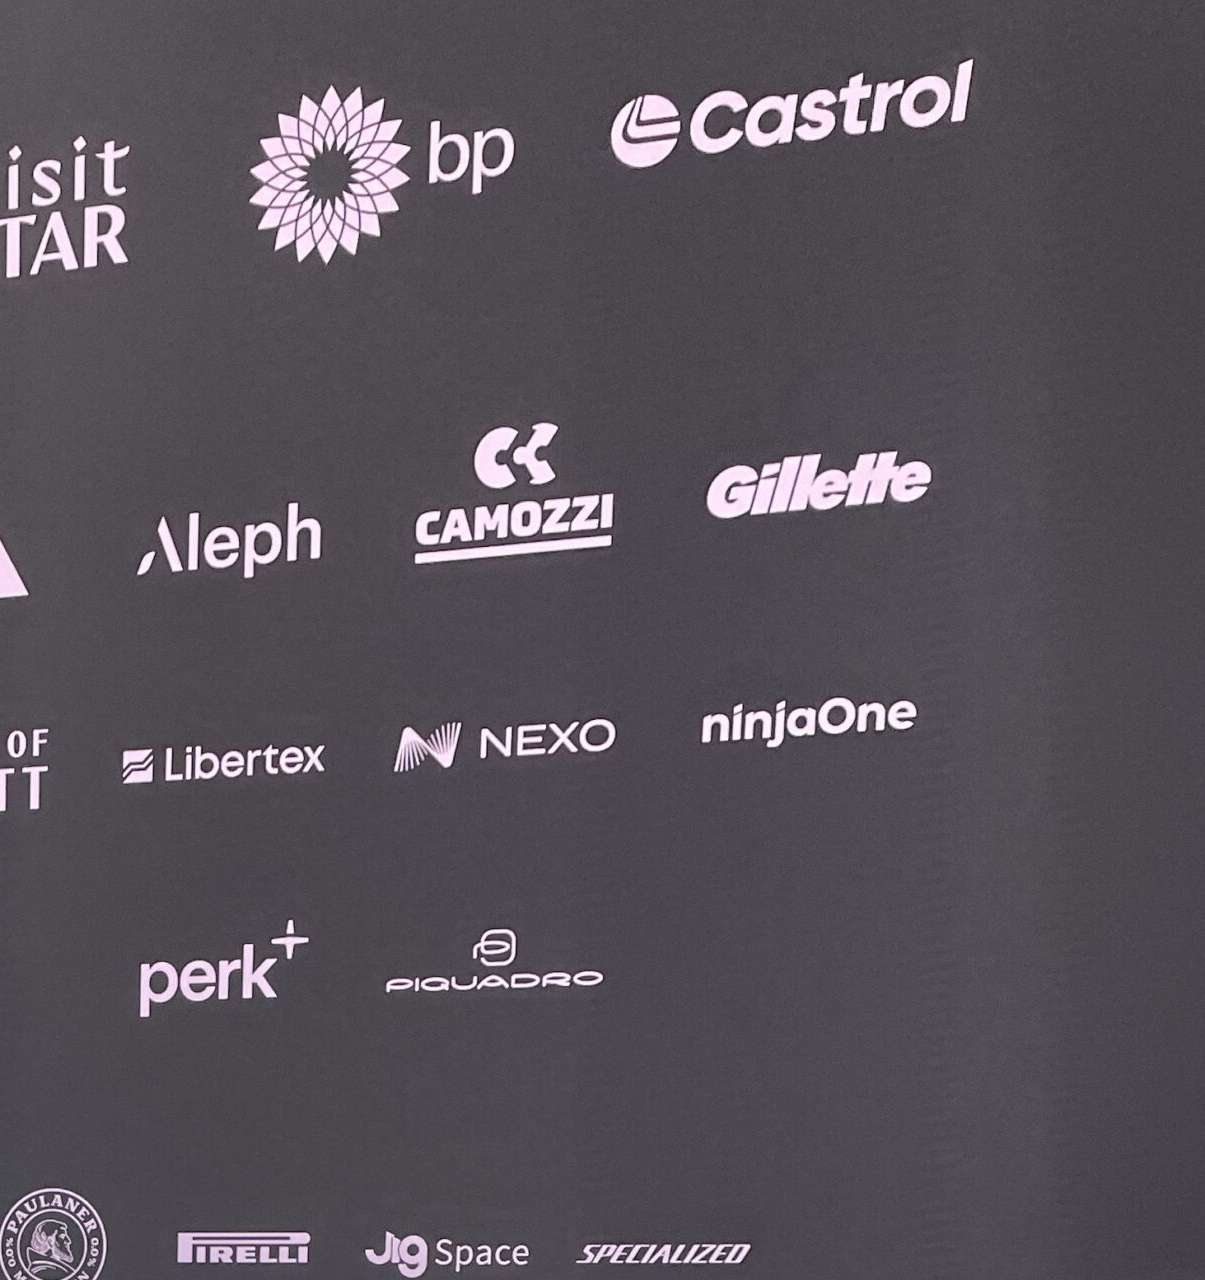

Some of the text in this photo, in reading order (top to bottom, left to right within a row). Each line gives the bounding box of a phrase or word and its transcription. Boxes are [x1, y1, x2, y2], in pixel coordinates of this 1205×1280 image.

[690, 58, 974, 154] Castrol
[428, 120, 515, 195] bp
[706, 450, 932, 519] Gillette
[414, 493, 614, 546] CAMOZZI
[137, 502, 322, 579] Aleph
[479, 718, 616, 759] NEXO
[701, 697, 917, 748] ninjaOne
[7, 728, 49, 759] OF
[165, 744, 325, 782] Libertex
[139, 942, 278, 1018] perk
[385, 970, 604, 993] PIQUADRO
[6, 1193, 98, 1234] PAULANER
[177, 1232, 311, 1264] PIRELLI
[435, 1238, 530, 1273] Space
[575, 1243, 751, 1264] SPECIALIZED
